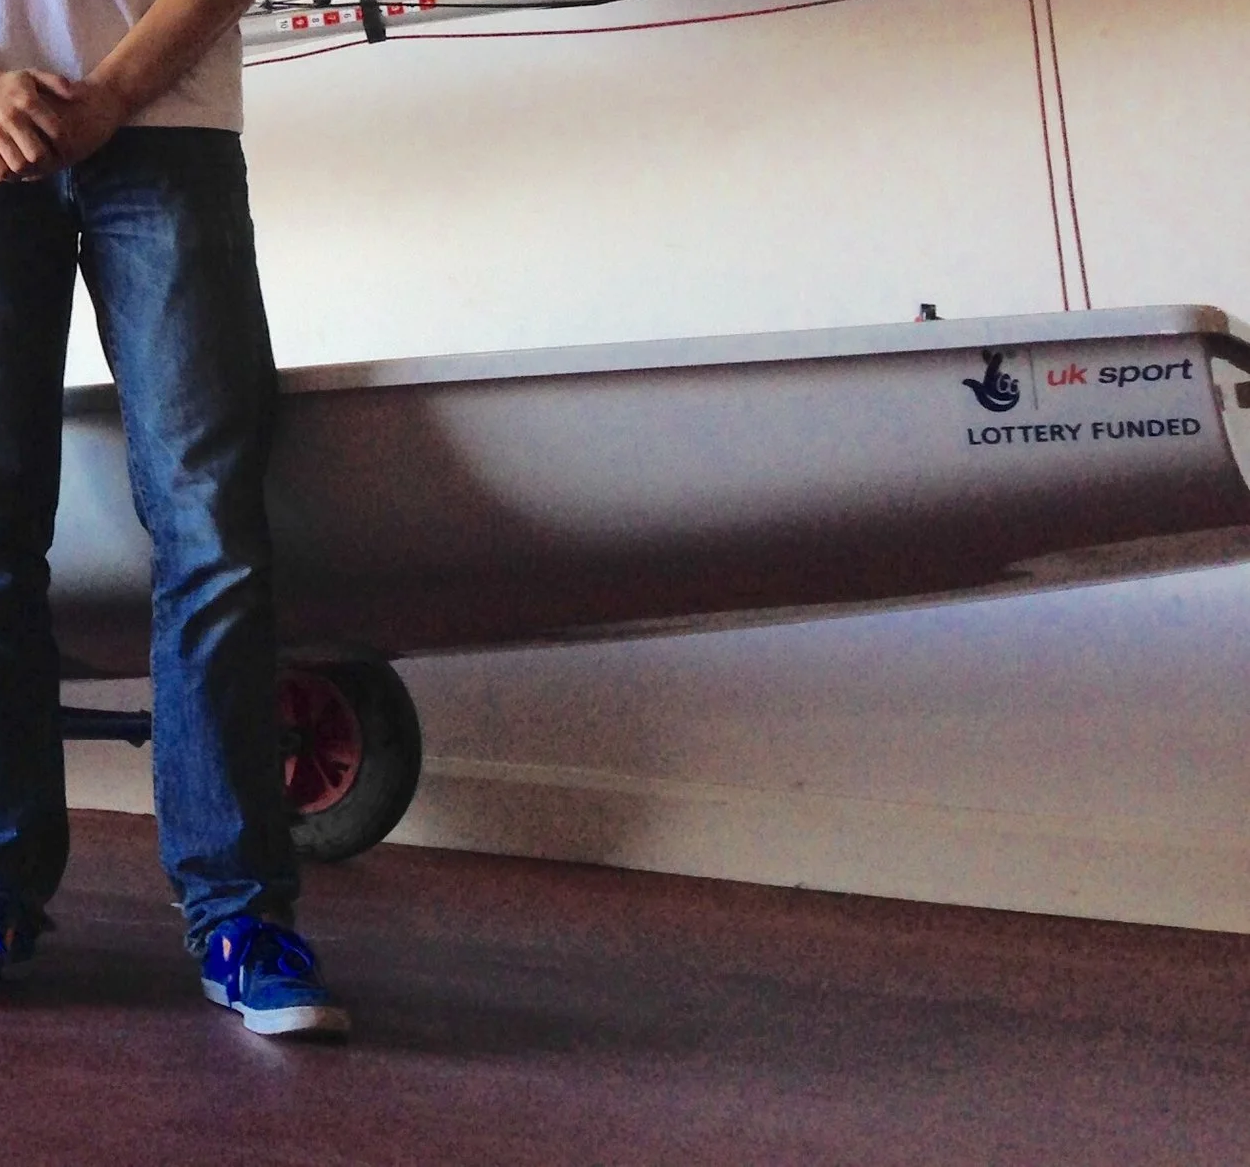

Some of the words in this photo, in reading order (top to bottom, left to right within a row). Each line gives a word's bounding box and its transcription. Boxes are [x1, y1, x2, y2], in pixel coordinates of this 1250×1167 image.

[1046, 363, 1088, 387] uk
[1098, 358, 1194, 388] sport
[967, 422, 1083, 446] LOTTERY
[1092, 417, 1202, 441] FUNDED
